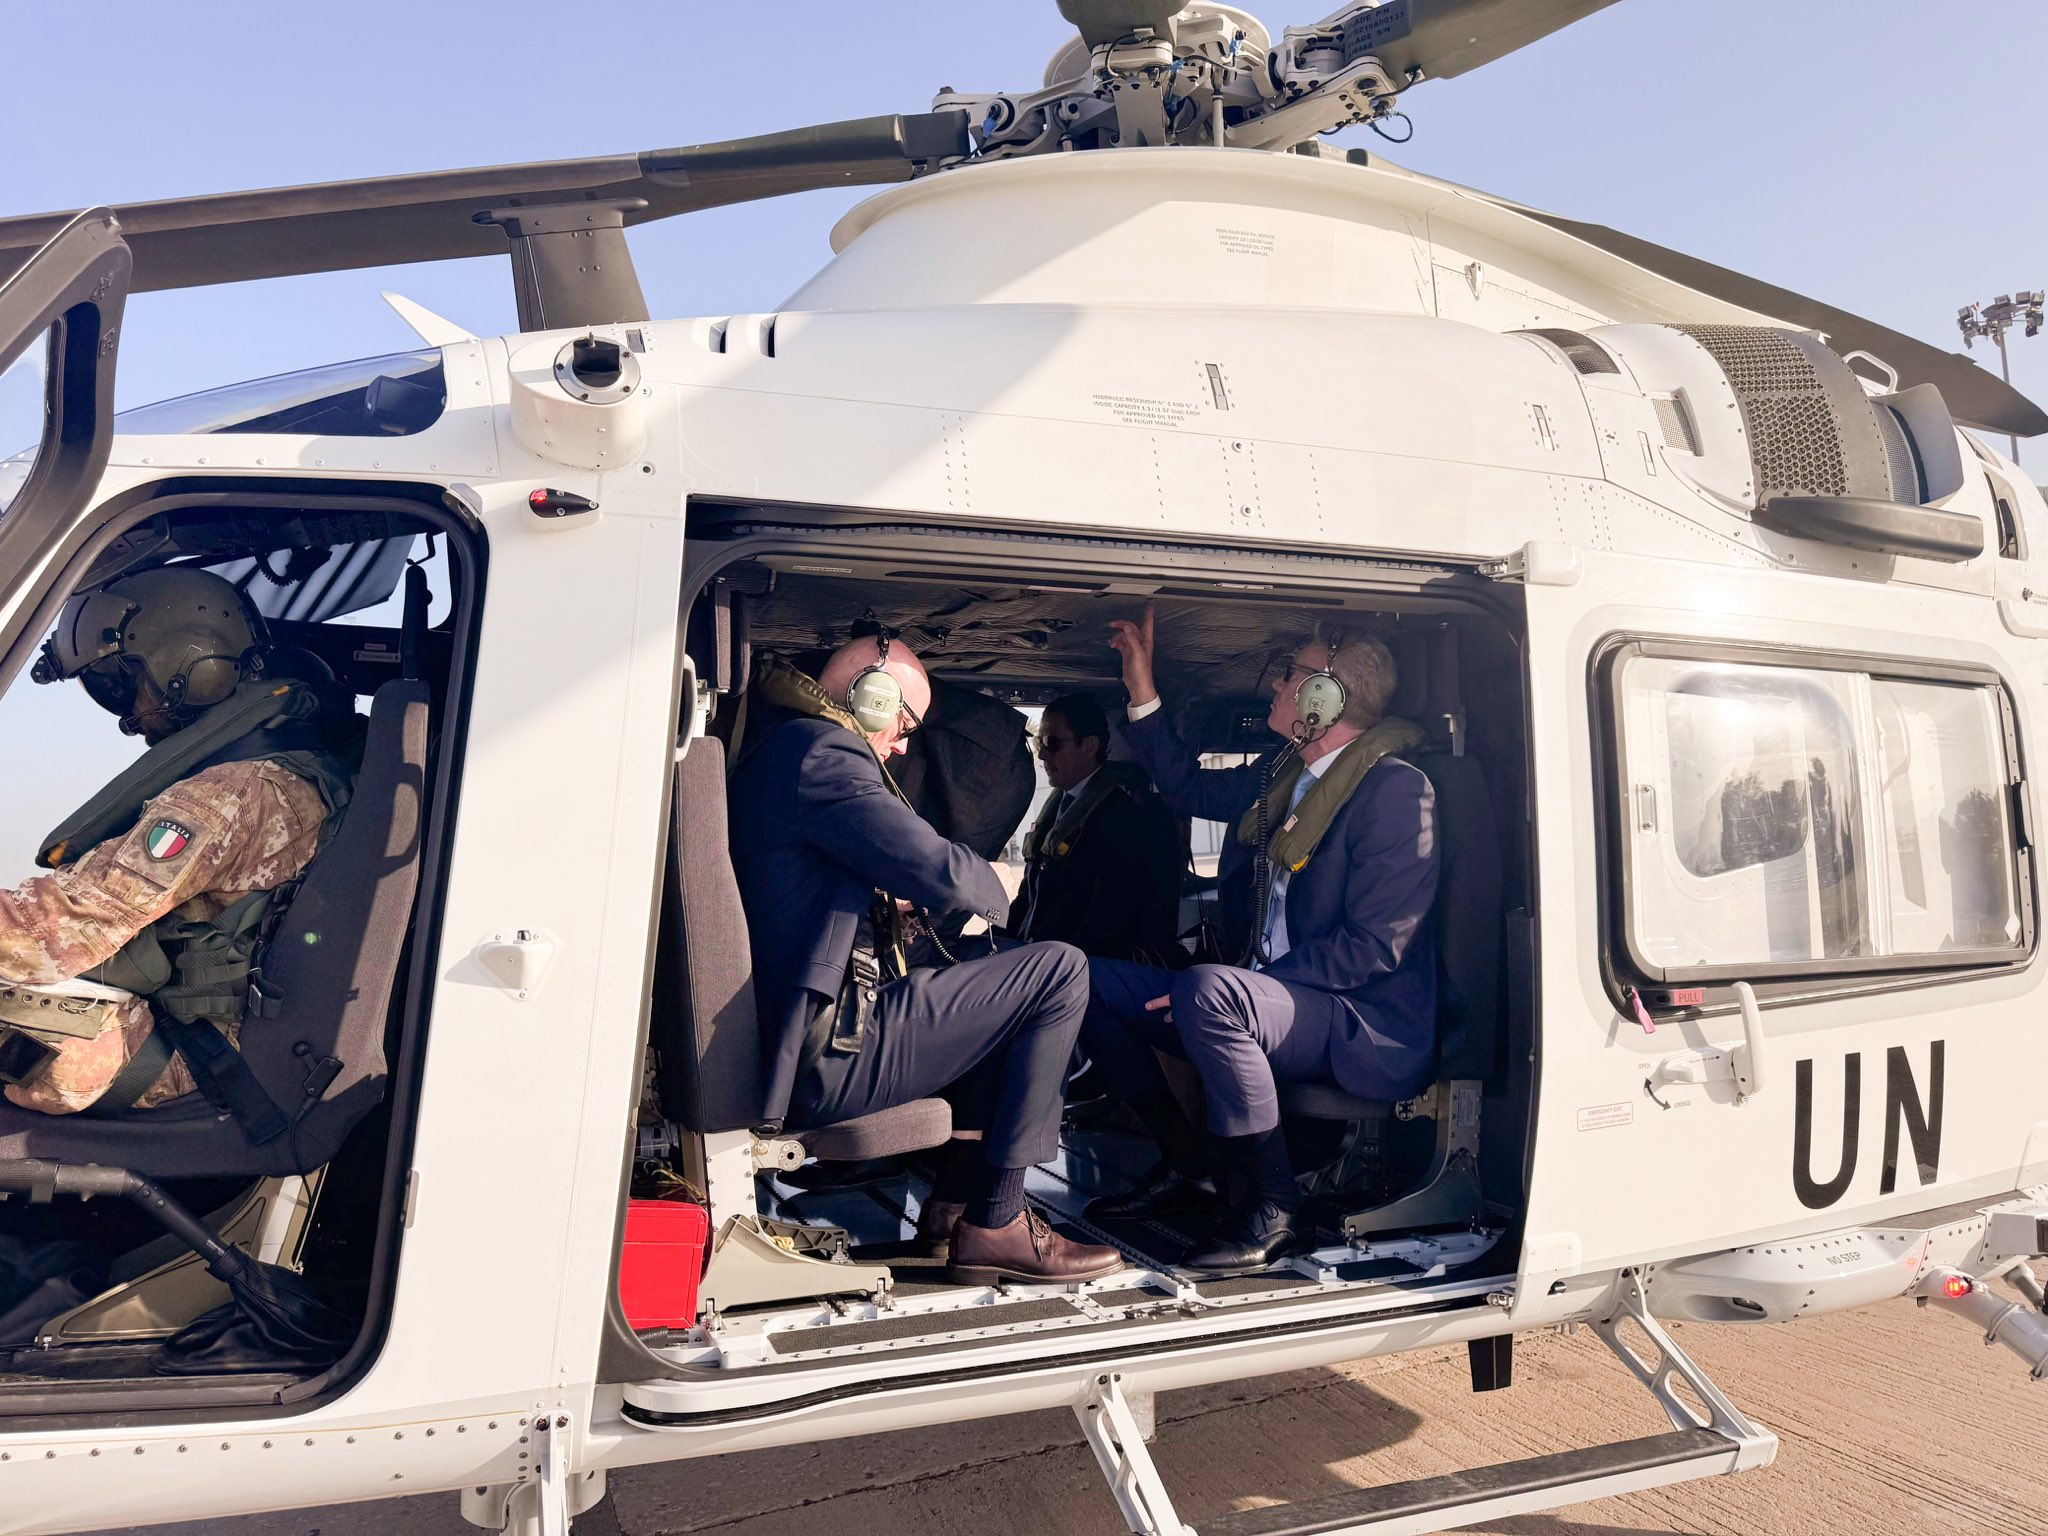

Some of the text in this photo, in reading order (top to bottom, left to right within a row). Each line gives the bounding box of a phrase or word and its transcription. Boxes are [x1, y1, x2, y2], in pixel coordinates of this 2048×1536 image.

[1092, 394, 1125, 402] HYDRAULIC
[1126, 411, 1156, 419] APPROVED
[1154, 420, 1178, 428] MANUAL
[160, 821, 190, 839] ITALIA
[1678, 992, 1699, 1004] PULL
[1673, 1100, 1692, 1109] LOCKED
[1793, 1039, 1945, 1210] UN
[1826, 1251, 1861, 1265] NO STEP
